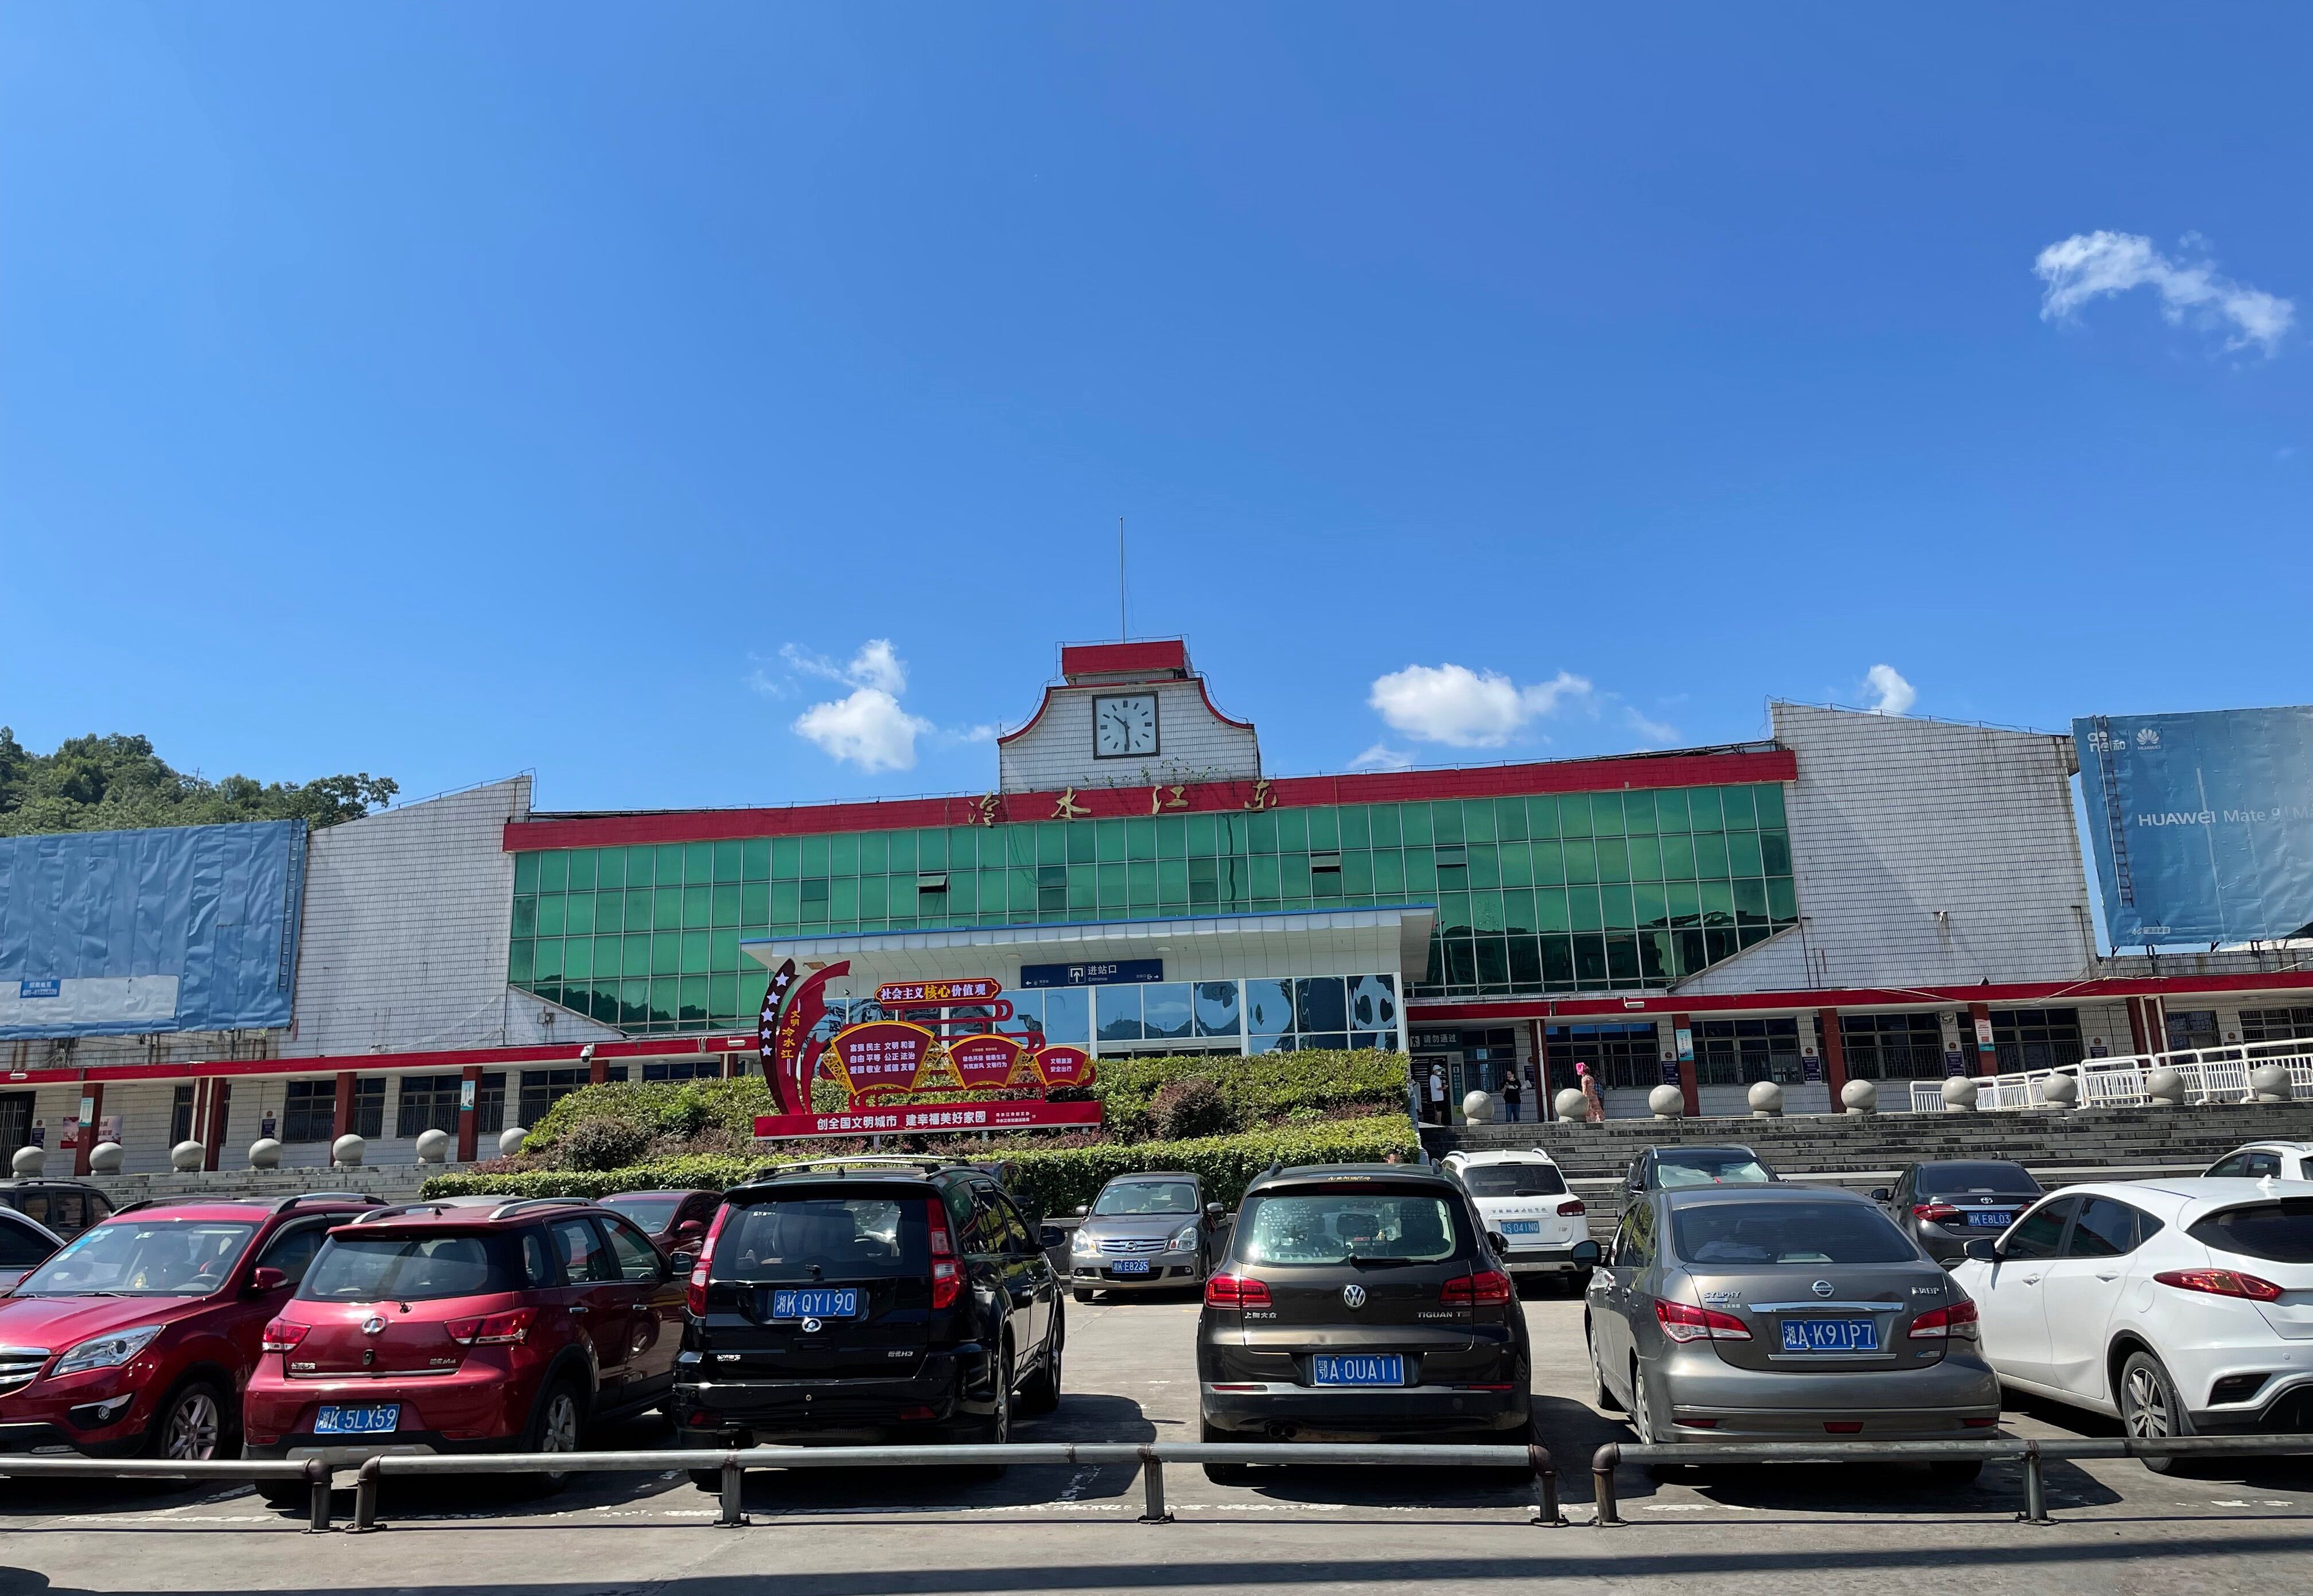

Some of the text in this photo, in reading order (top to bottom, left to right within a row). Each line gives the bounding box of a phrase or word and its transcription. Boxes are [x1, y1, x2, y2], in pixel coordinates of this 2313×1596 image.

[2138, 809, 2216, 827] HUAWEI
[2223, 808, 2265, 823] Mate
[2271, 807, 2280, 820] 9
[1087, 965, 1117, 975] 进站口
[881, 983, 986, 1001] 社会主义核心价值观
[791, 1010, 801, 1026] 文明
[781, 1027, 796, 1058] 冷水江
[1423, 1034, 1457, 1044] 请勿通过
[817, 1111, 987, 1131] 创全国文明城市 建幸福美好家园
